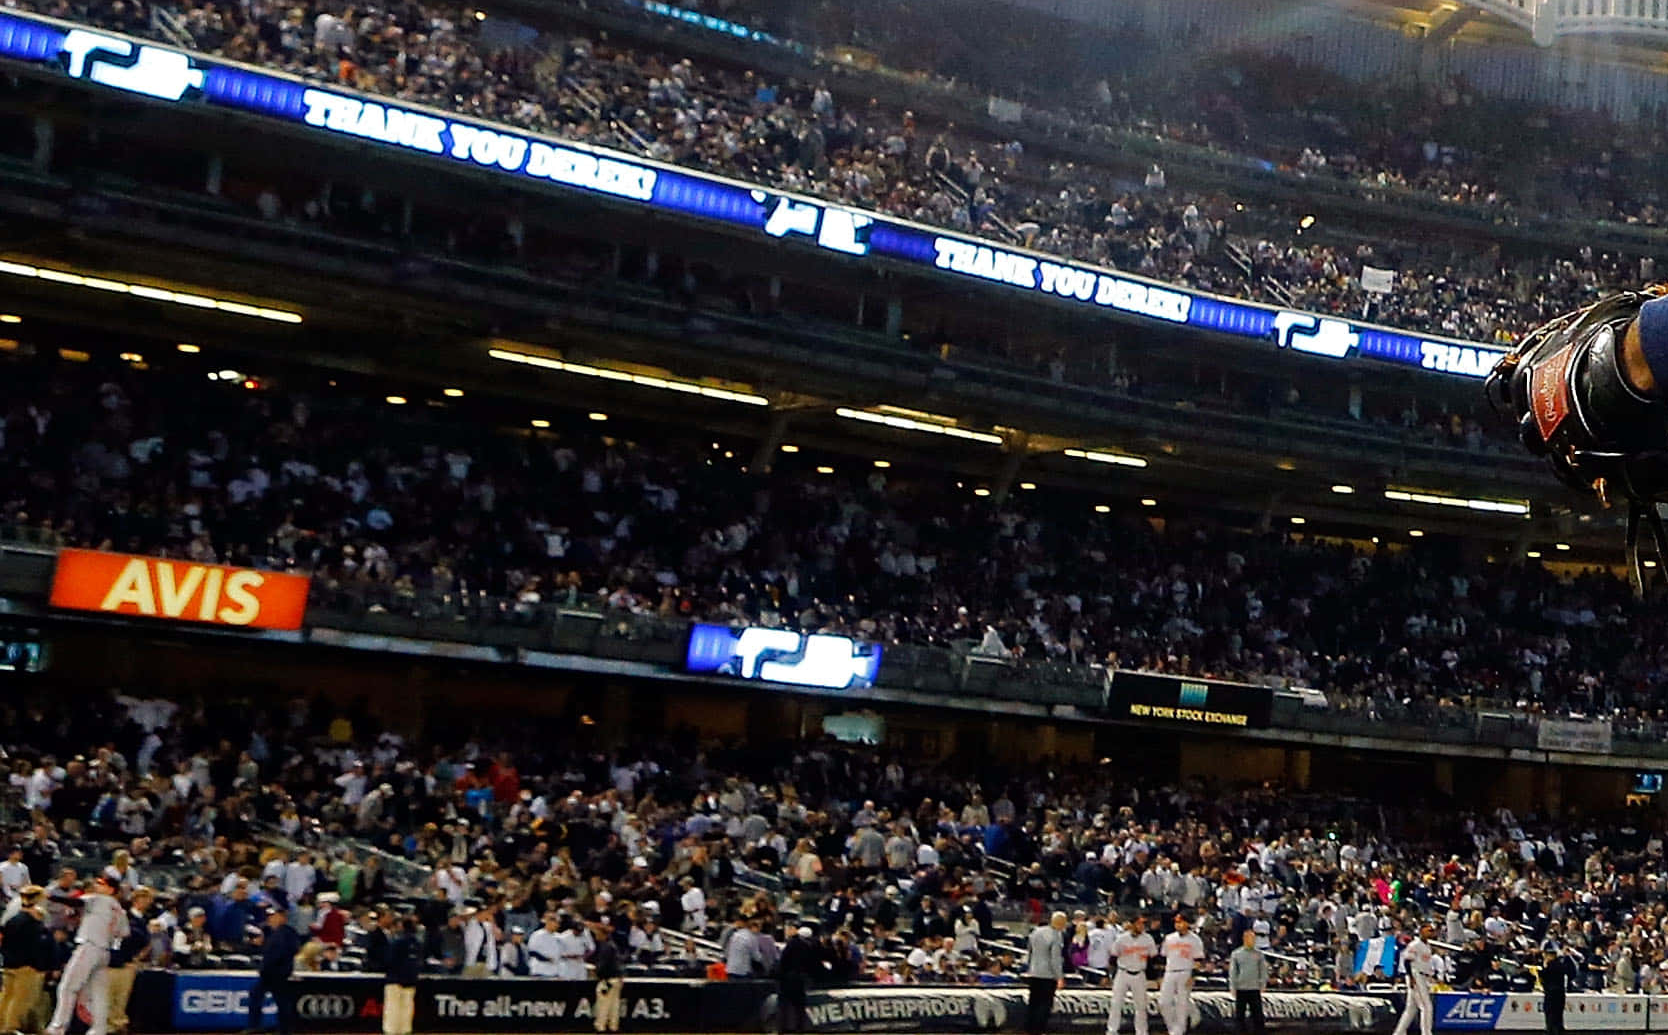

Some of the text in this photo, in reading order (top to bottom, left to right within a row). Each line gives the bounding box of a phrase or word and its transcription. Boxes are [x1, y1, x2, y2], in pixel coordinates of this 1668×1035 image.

[303, 89, 657, 201] THANK YOU DEREK!
[935, 237, 1192, 322] THANK YOU DEREK!
[1421, 341, 1503, 377] THAN
[101, 558, 264, 625] AVIS
[1130, 704, 1248, 726] NEW YORK STOCK EXCHANGE
[434, 994, 479, 1016] The
[482, 994, 566, 1017] all-new
[805, 997, 973, 1025] WEATHERPROOF
[1446, 999, 1496, 1018] ACC
